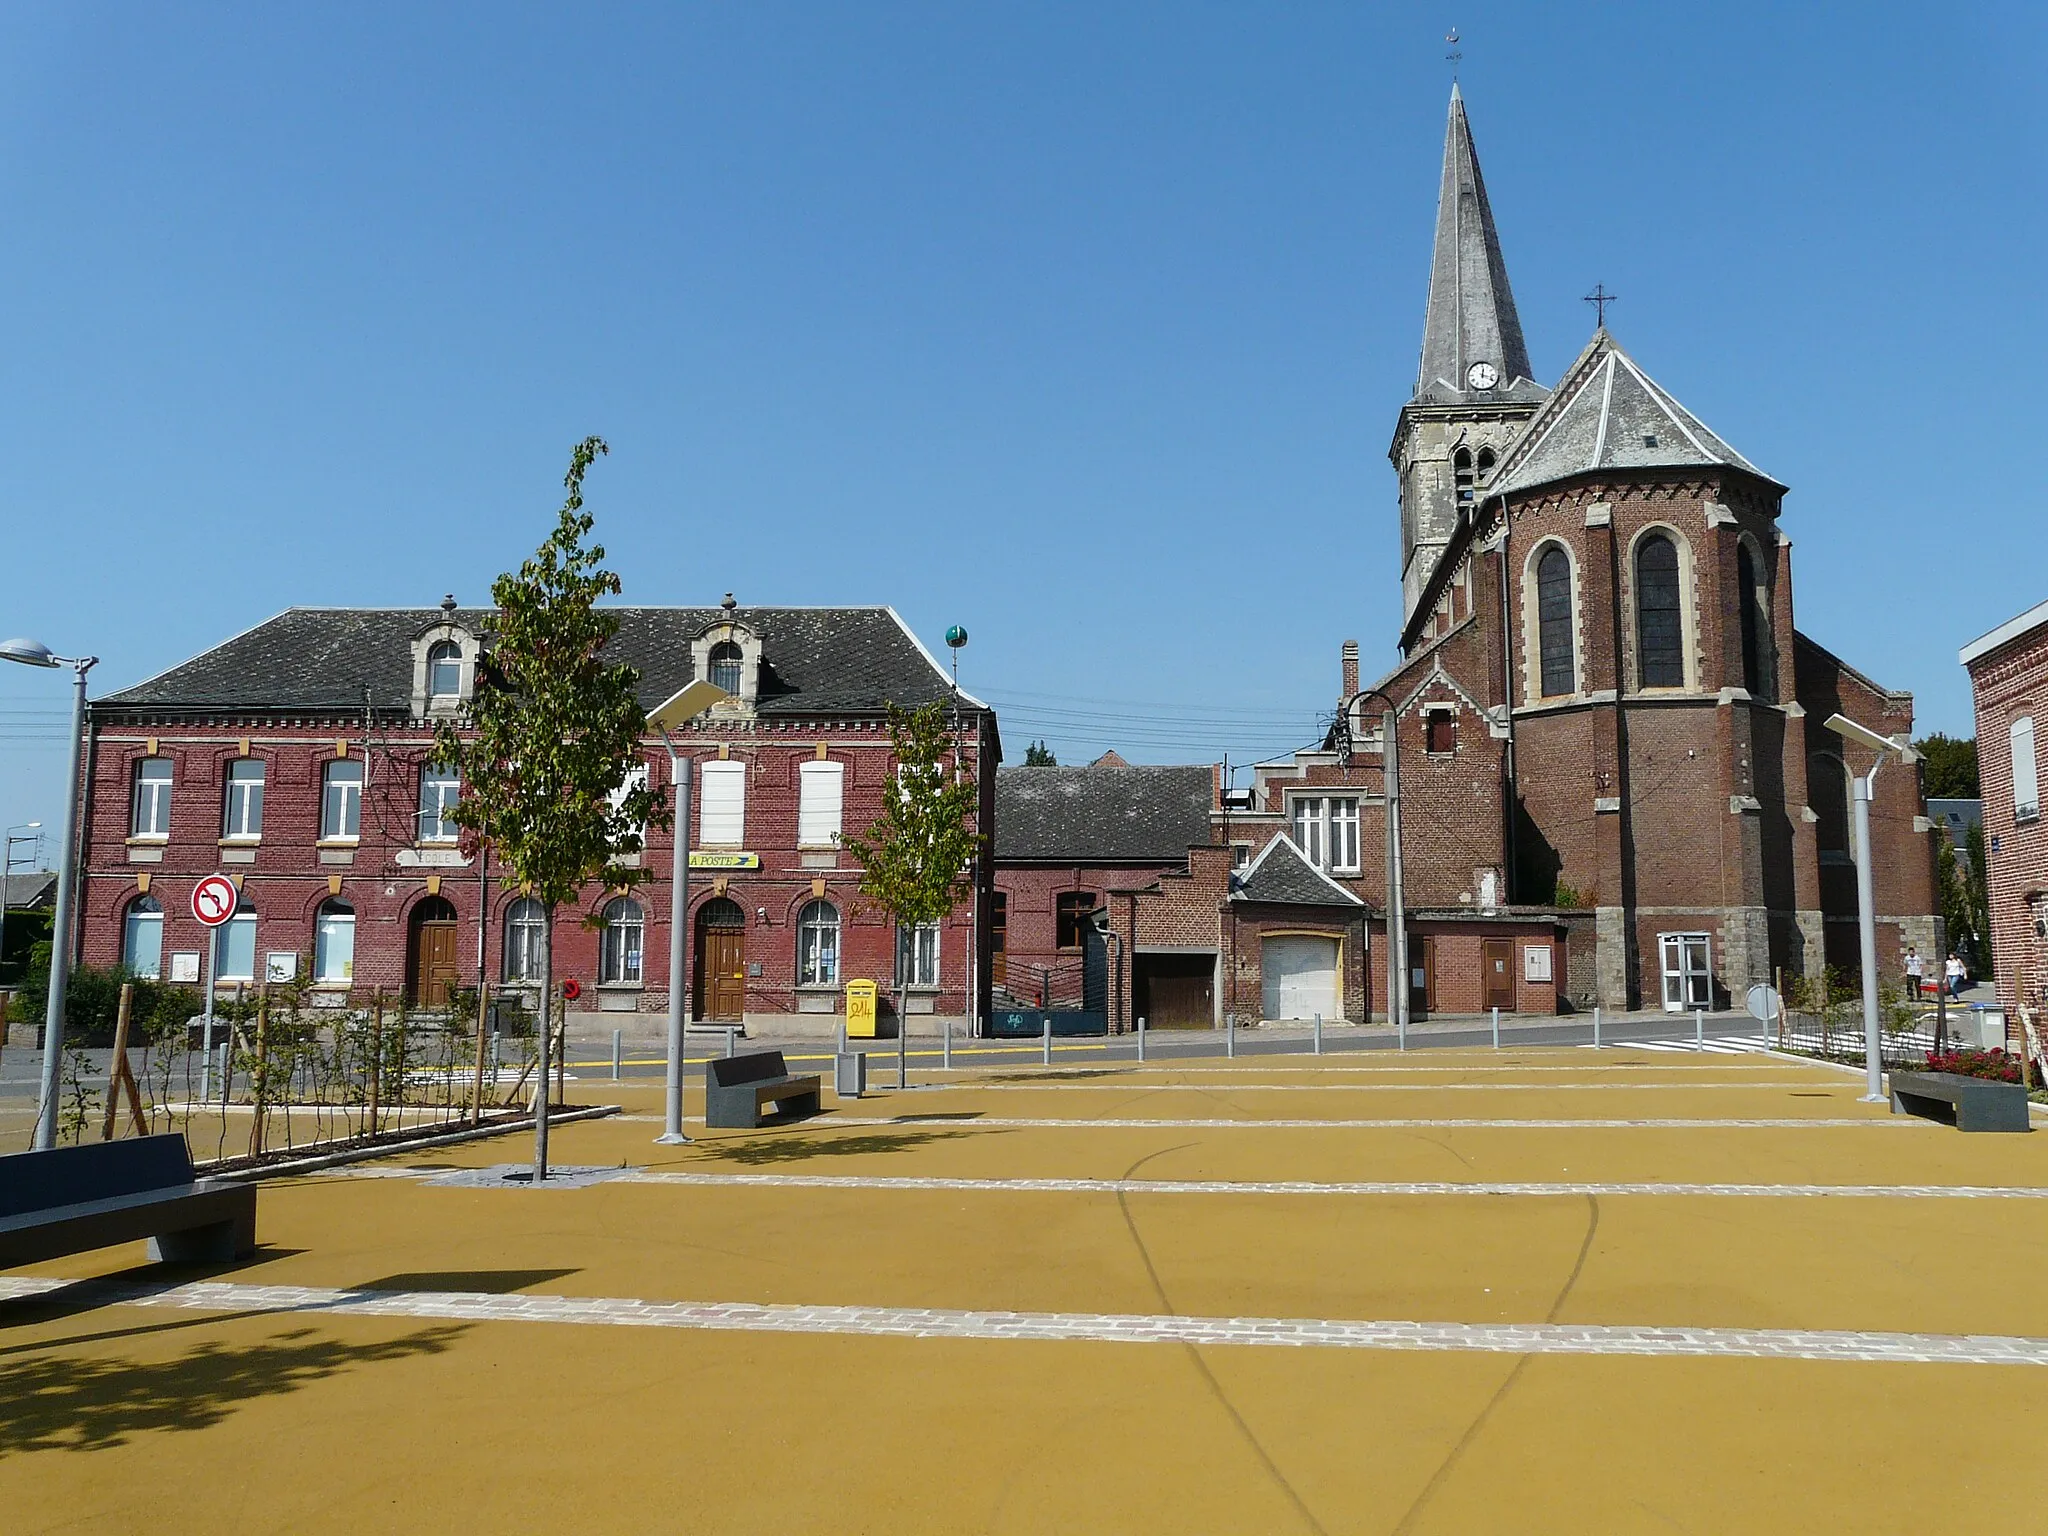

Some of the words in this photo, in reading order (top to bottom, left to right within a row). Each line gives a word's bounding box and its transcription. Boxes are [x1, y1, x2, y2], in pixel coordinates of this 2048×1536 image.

[690, 856, 697, 866] A
[701, 856, 733, 866] POSTE
[849, 1000, 873, 1019] 214
